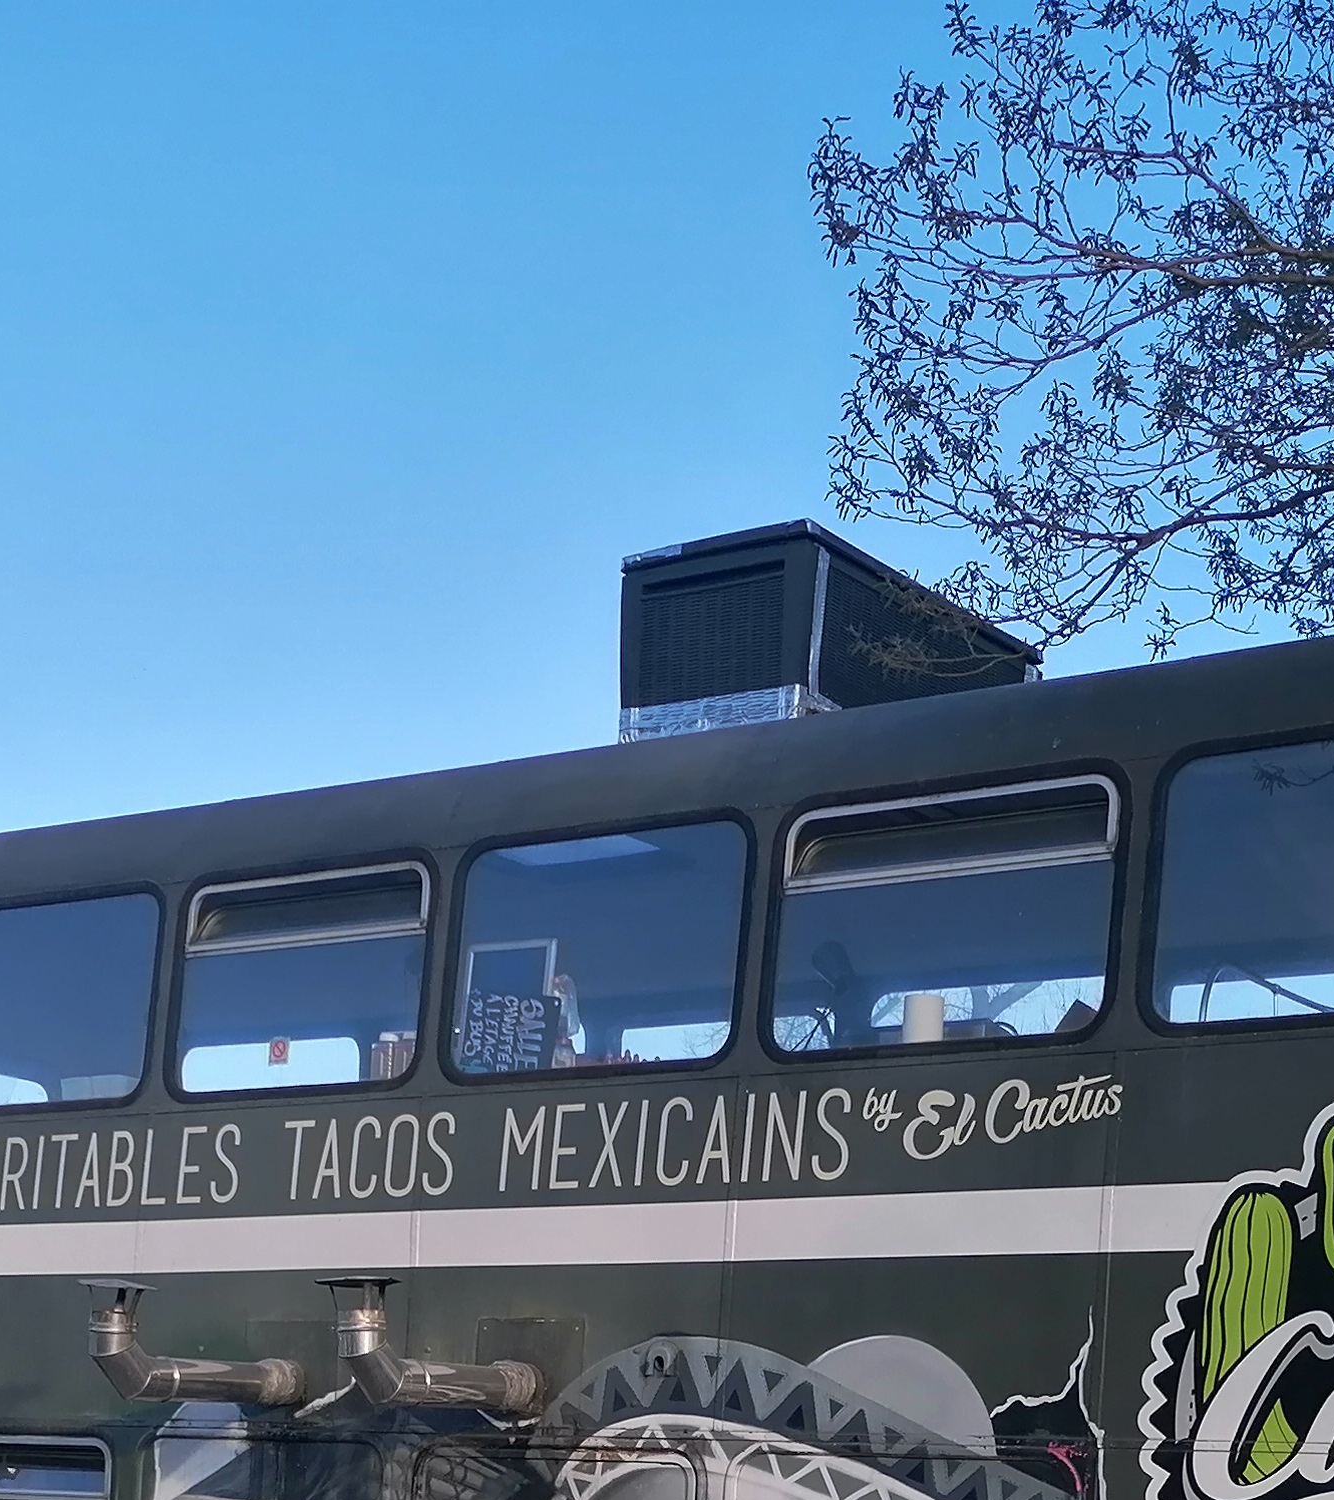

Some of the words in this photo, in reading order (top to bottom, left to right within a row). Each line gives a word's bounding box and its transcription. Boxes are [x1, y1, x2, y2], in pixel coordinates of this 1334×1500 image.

[463, 1019, 484, 1057] BUS
[512, 998, 546, 1070] SALLE
[284, 1111, 456, 1201] TACOS
[498, 1087, 852, 1193] MEXICAINS
[862, 1087, 902, 1132] by
[902, 1089, 976, 1161] El
[984, 1073, 1123, 1145] Cactus
